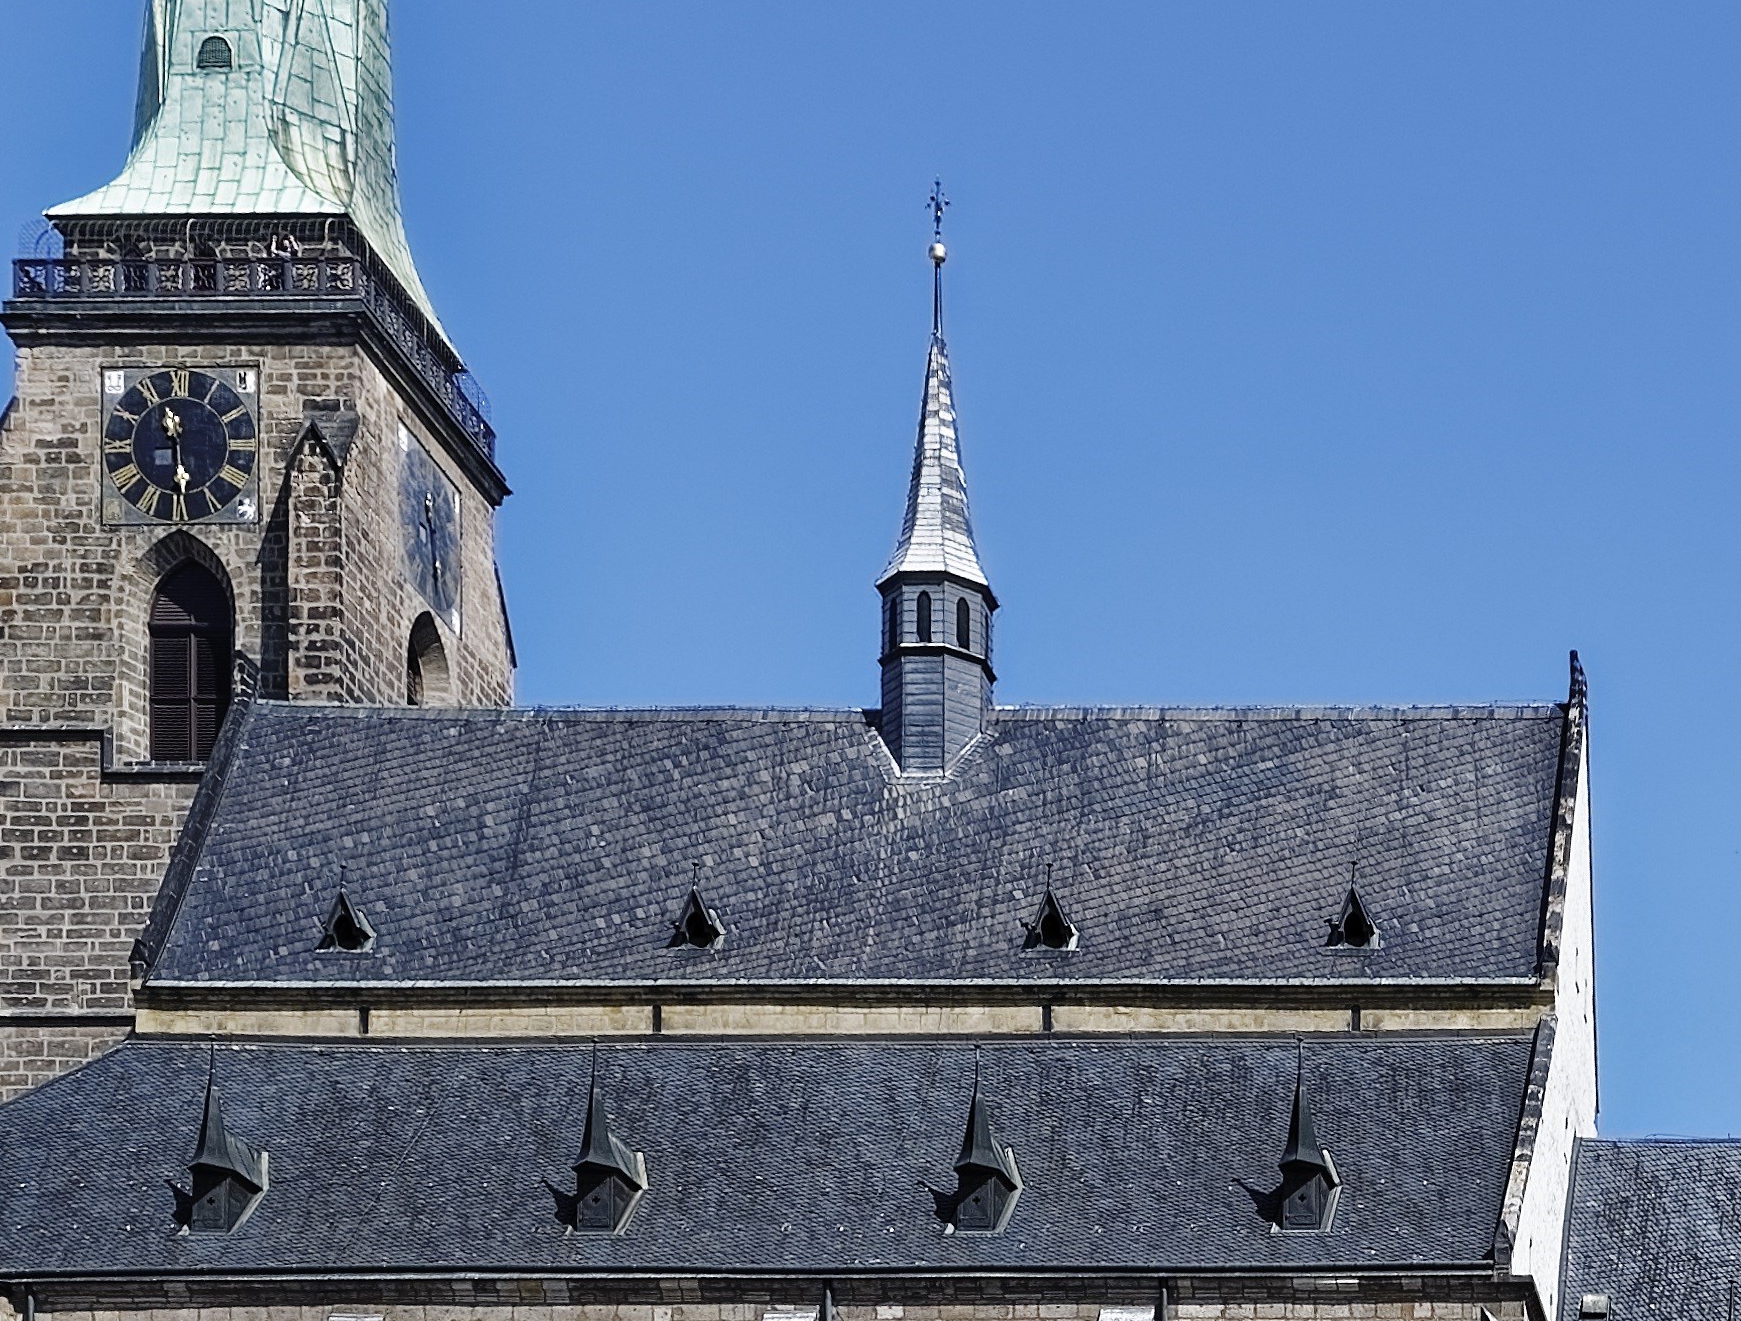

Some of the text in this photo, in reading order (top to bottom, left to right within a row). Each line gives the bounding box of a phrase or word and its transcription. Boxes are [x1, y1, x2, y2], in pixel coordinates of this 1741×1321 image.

[136, 379, 160, 408] XI
[170, 370, 190, 397] XII
[204, 379, 220, 404] I
[113, 405, 140, 425] X
[221, 404, 247, 424] II
[228, 438, 256, 452] III
